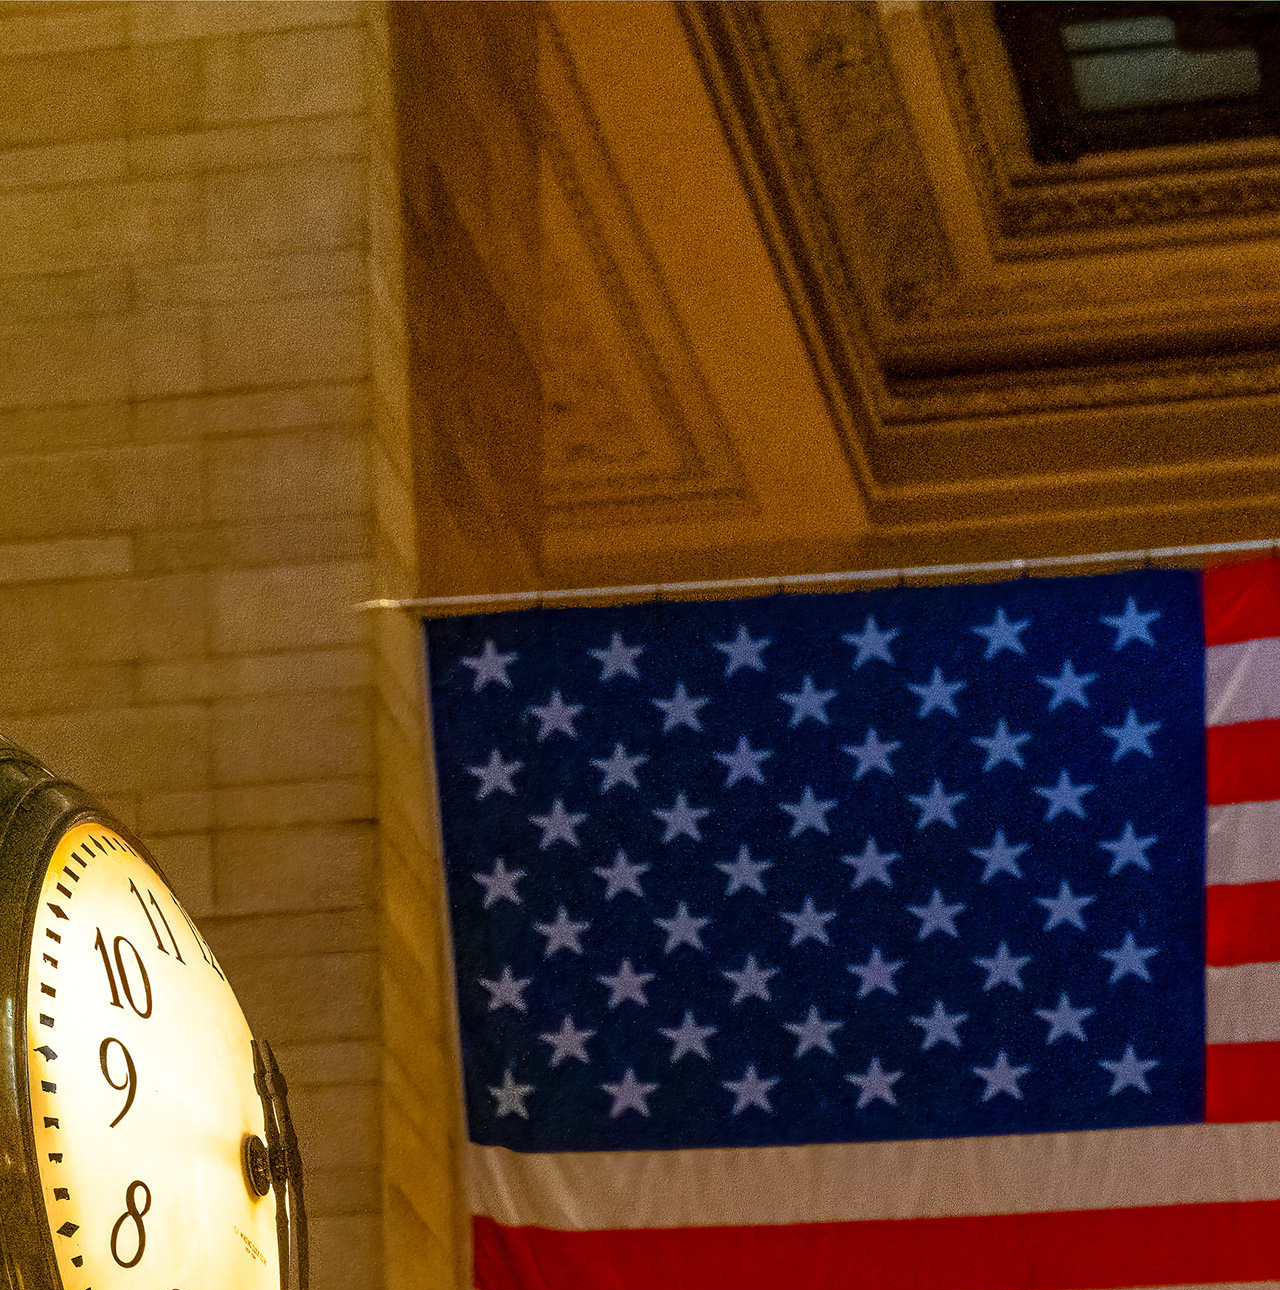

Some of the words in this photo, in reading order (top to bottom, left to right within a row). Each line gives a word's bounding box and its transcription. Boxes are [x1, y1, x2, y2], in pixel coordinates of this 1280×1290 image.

[127, 877, 186, 966] 11
[95, 926, 153, 1018] 10
[100, 1038, 136, 1128] 9
[111, 1181, 151, 1268] 8
